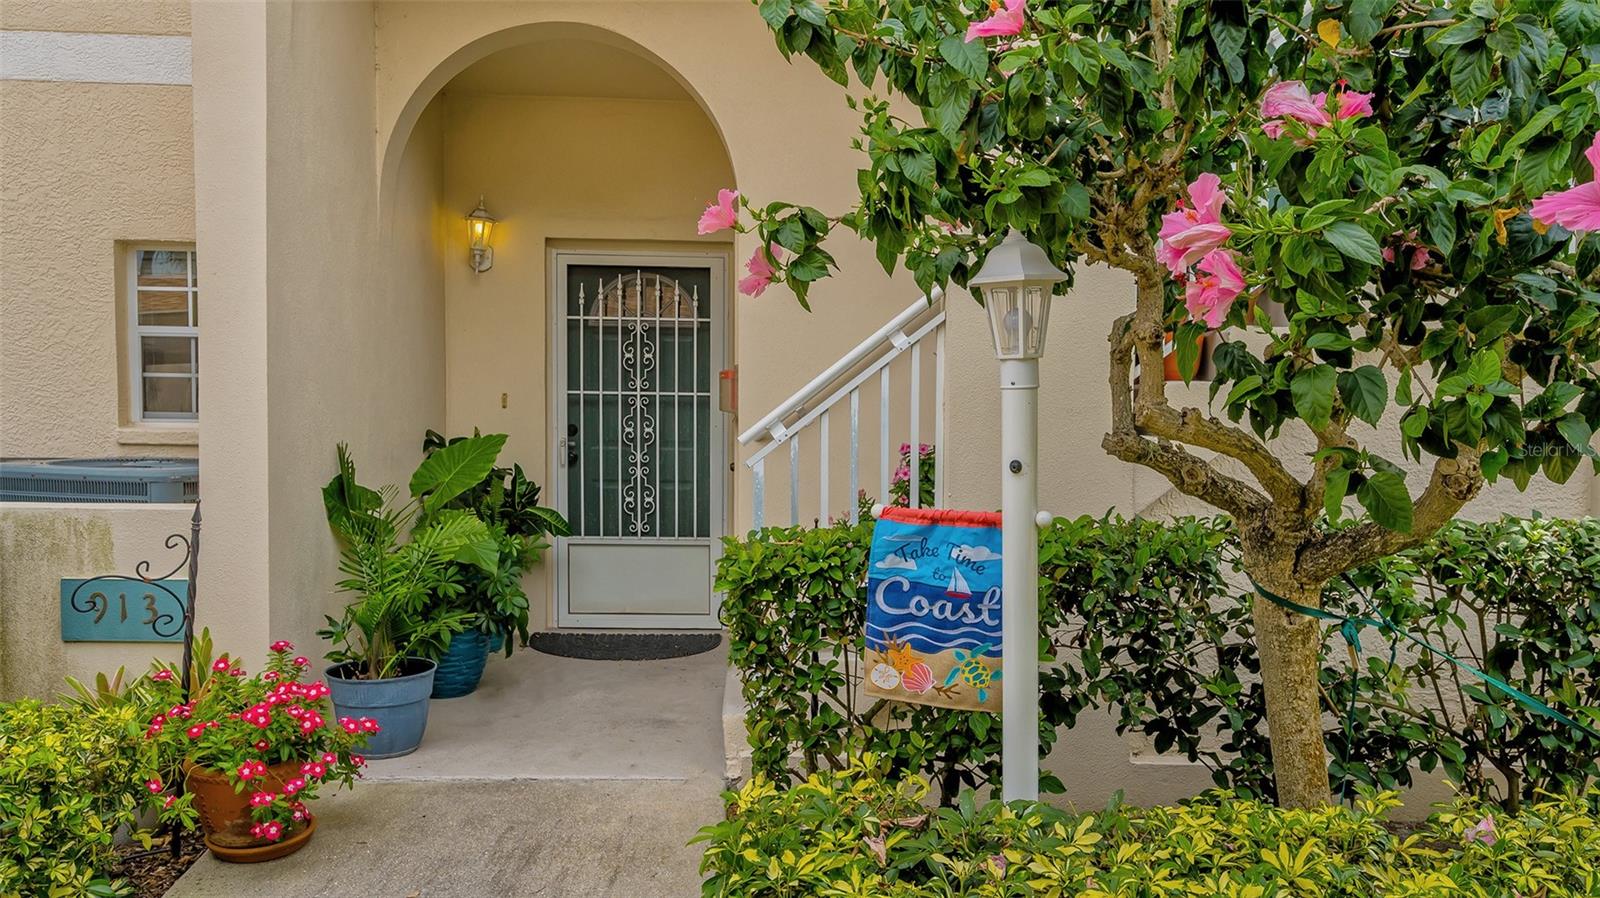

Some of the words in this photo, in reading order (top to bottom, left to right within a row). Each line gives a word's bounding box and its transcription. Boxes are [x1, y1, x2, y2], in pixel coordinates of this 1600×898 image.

[894, 537, 940, 562] Take
[946, 542, 986, 575] Time
[932, 567, 947, 581] to
[89, 592, 158, 624] 913
[875, 575, 1001, 627] Coast
